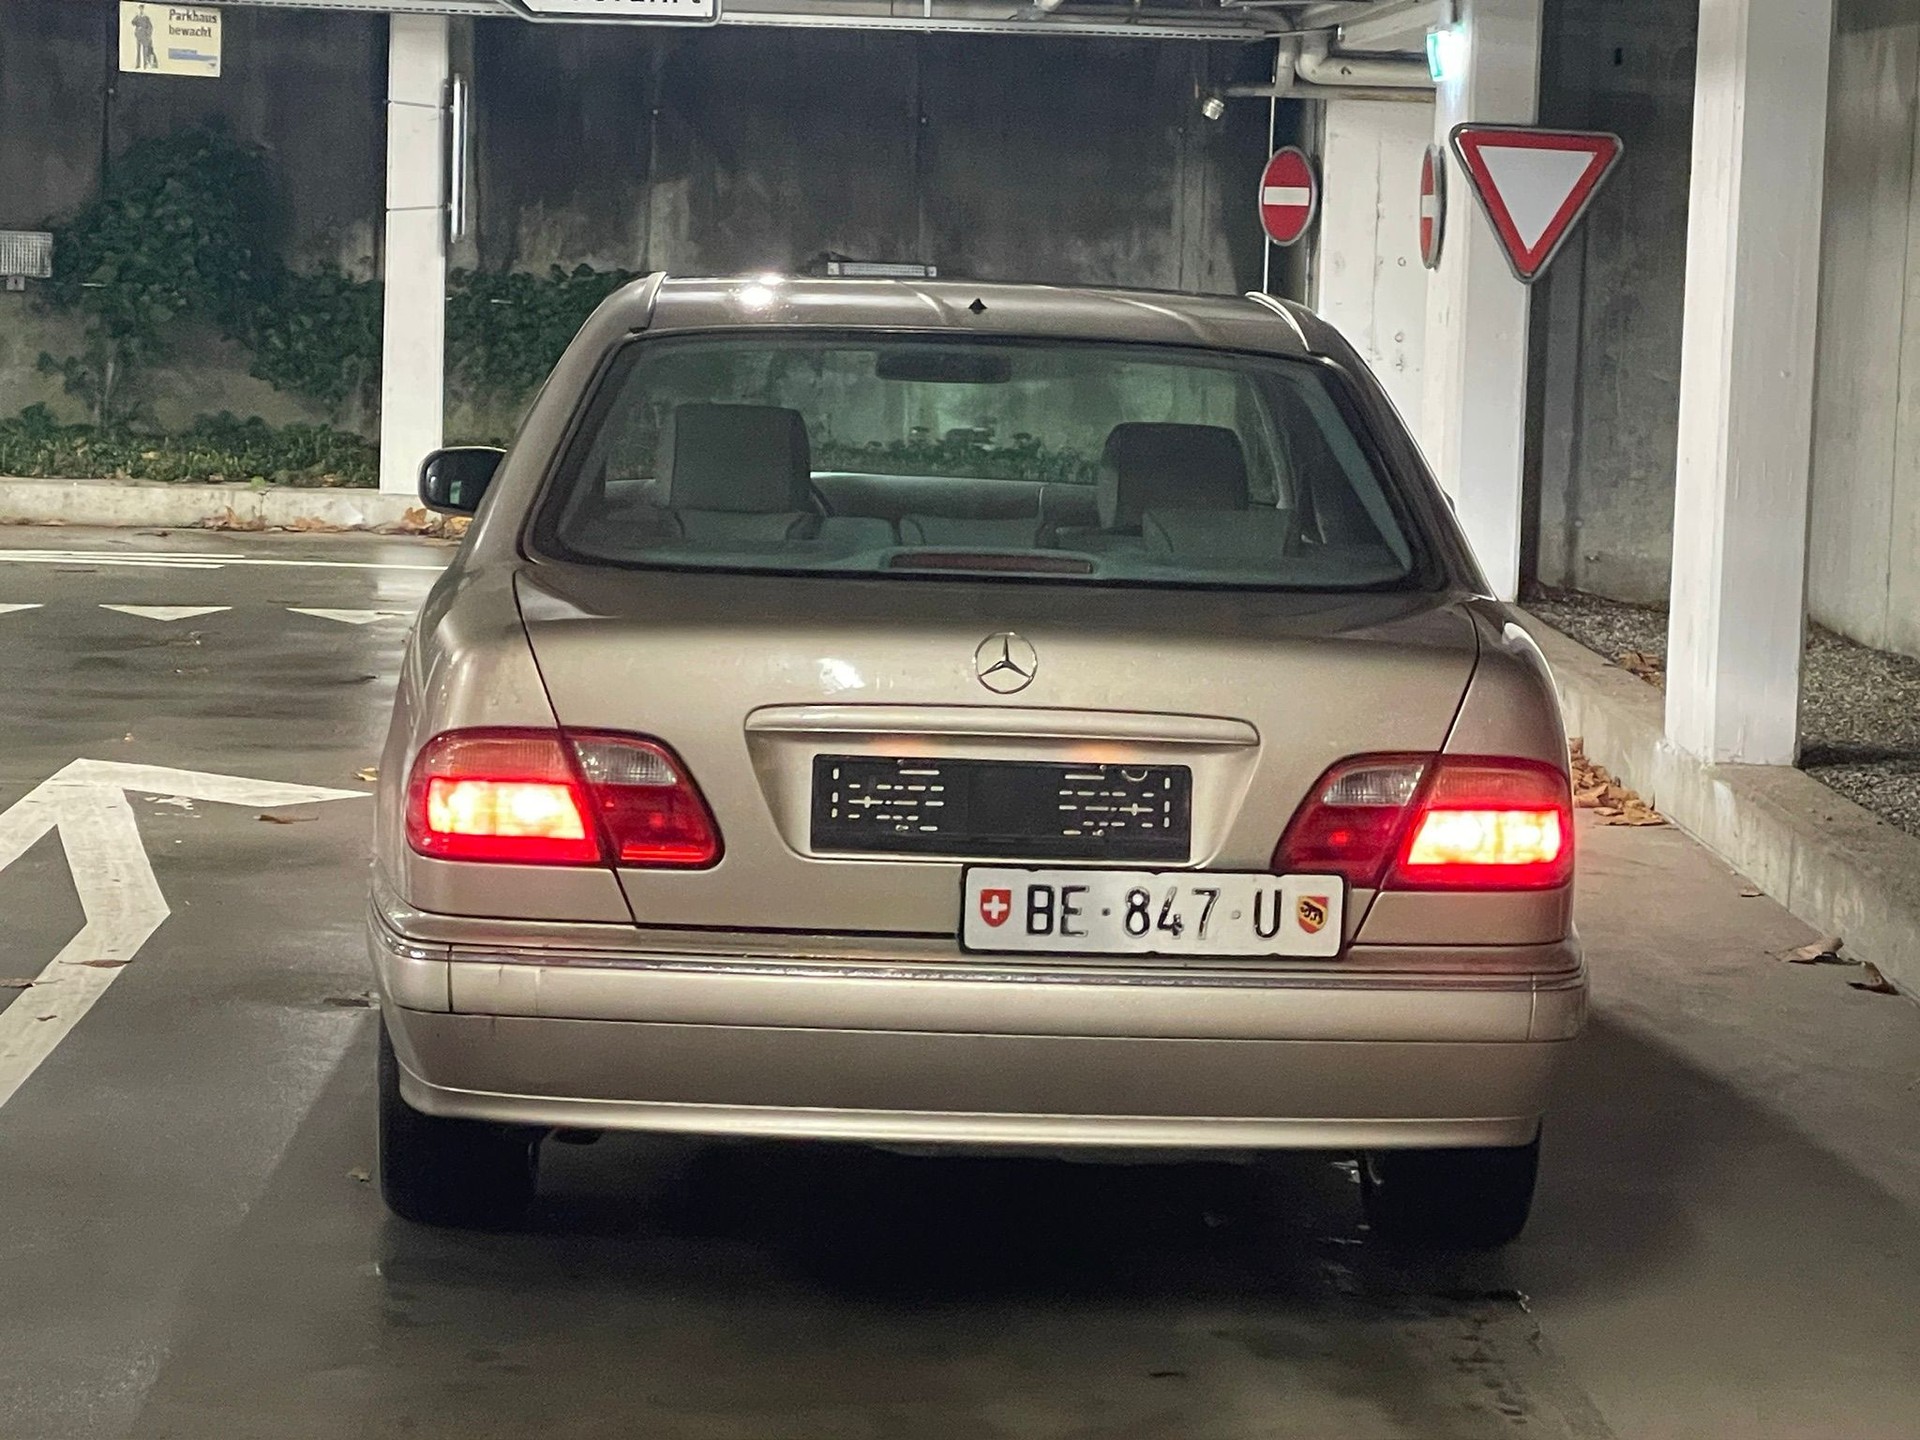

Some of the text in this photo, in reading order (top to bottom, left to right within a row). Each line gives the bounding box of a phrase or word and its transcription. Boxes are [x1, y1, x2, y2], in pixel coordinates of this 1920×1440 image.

[169, 9, 217, 24] Parkhaus
[169, 25, 212, 38] bewacht
[1125, 888, 1221, 940] 847
[1254, 889, 1282, 939] U
